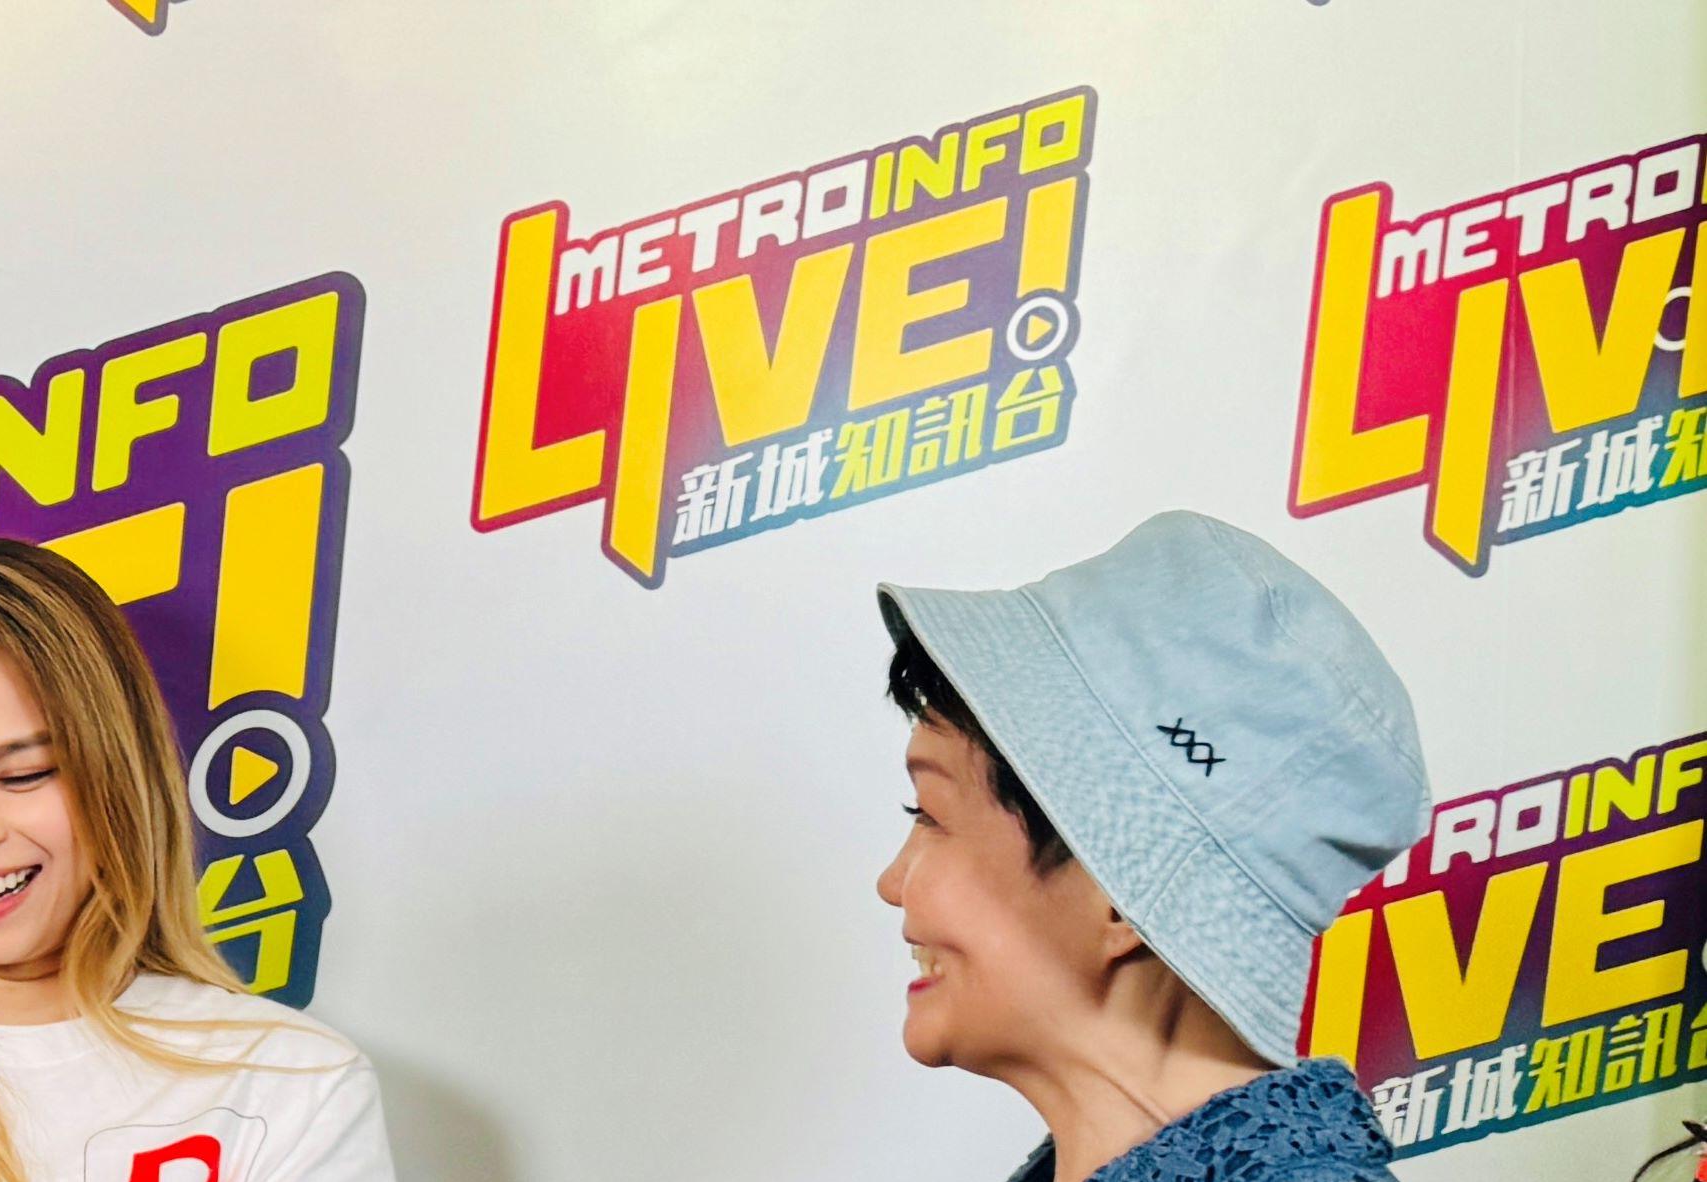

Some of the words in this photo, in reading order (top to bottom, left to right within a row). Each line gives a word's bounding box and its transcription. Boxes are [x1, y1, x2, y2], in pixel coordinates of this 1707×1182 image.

[1376, 143, 1707, 299] METRO
[478, 176, 1078, 580] LIVE!
[672, 364, 1065, 547] 新城知訊台
[1295, 190, 1707, 566] LIV
